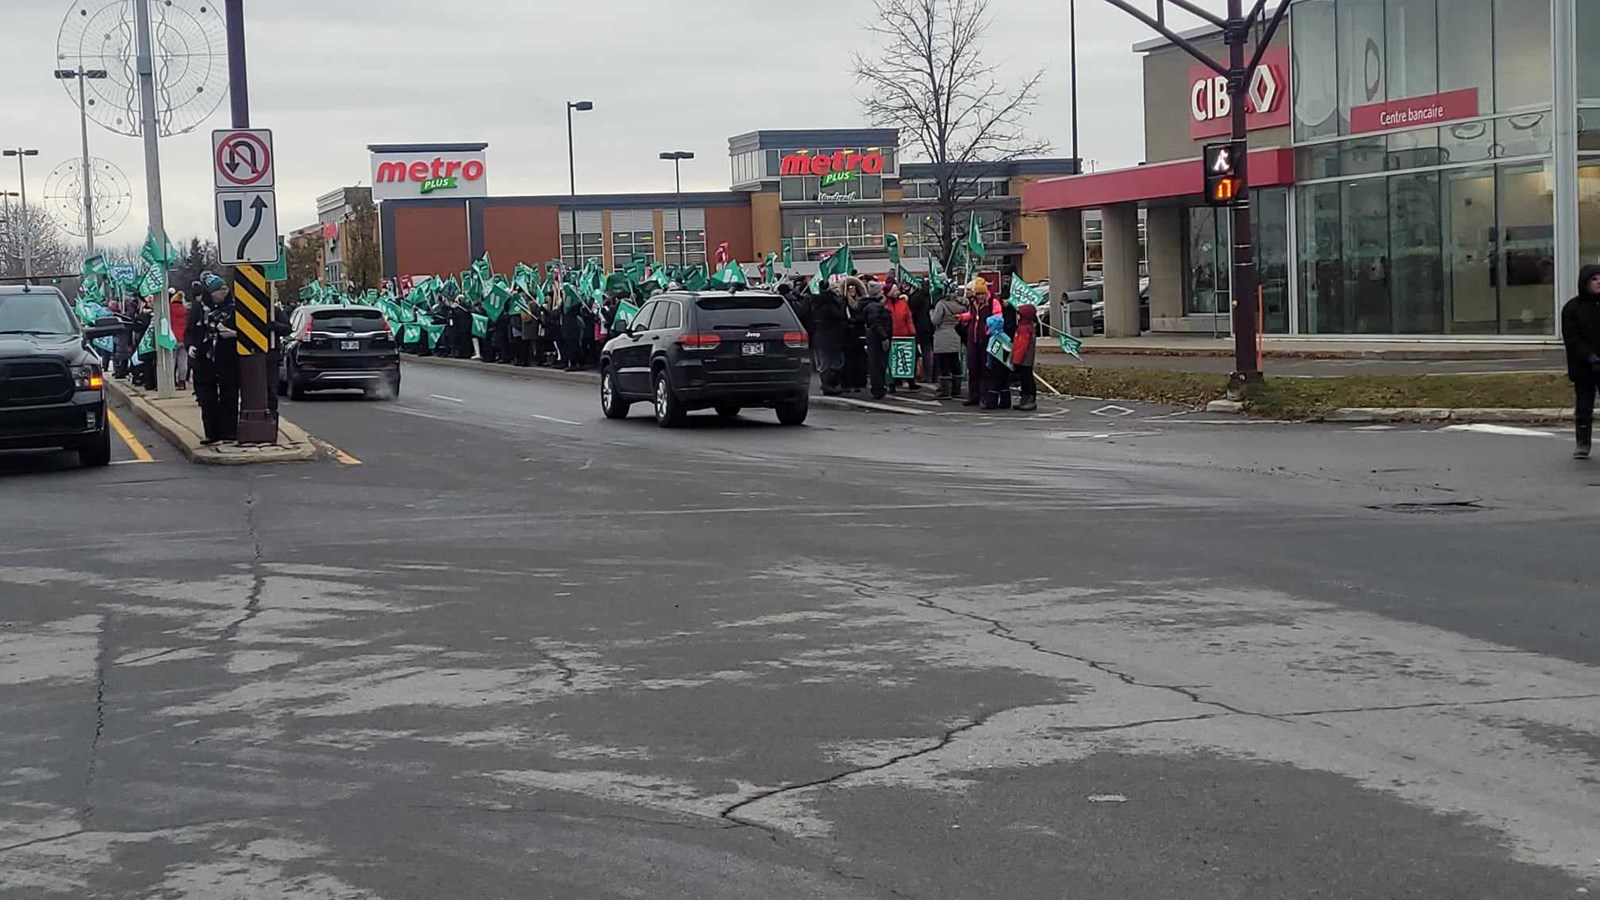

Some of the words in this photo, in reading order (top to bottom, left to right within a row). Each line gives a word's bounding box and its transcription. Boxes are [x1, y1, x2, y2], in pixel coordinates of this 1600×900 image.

[1191, 76, 1246, 121] CIB
[1380, 111, 1406, 125] Centre
[1408, 104, 1443, 121] bancaire
[376, 156, 484, 183] metro
[780, 149, 883, 176] metro
[424, 178, 449, 190] PLUS
[826, 171, 850, 183] PLUS
